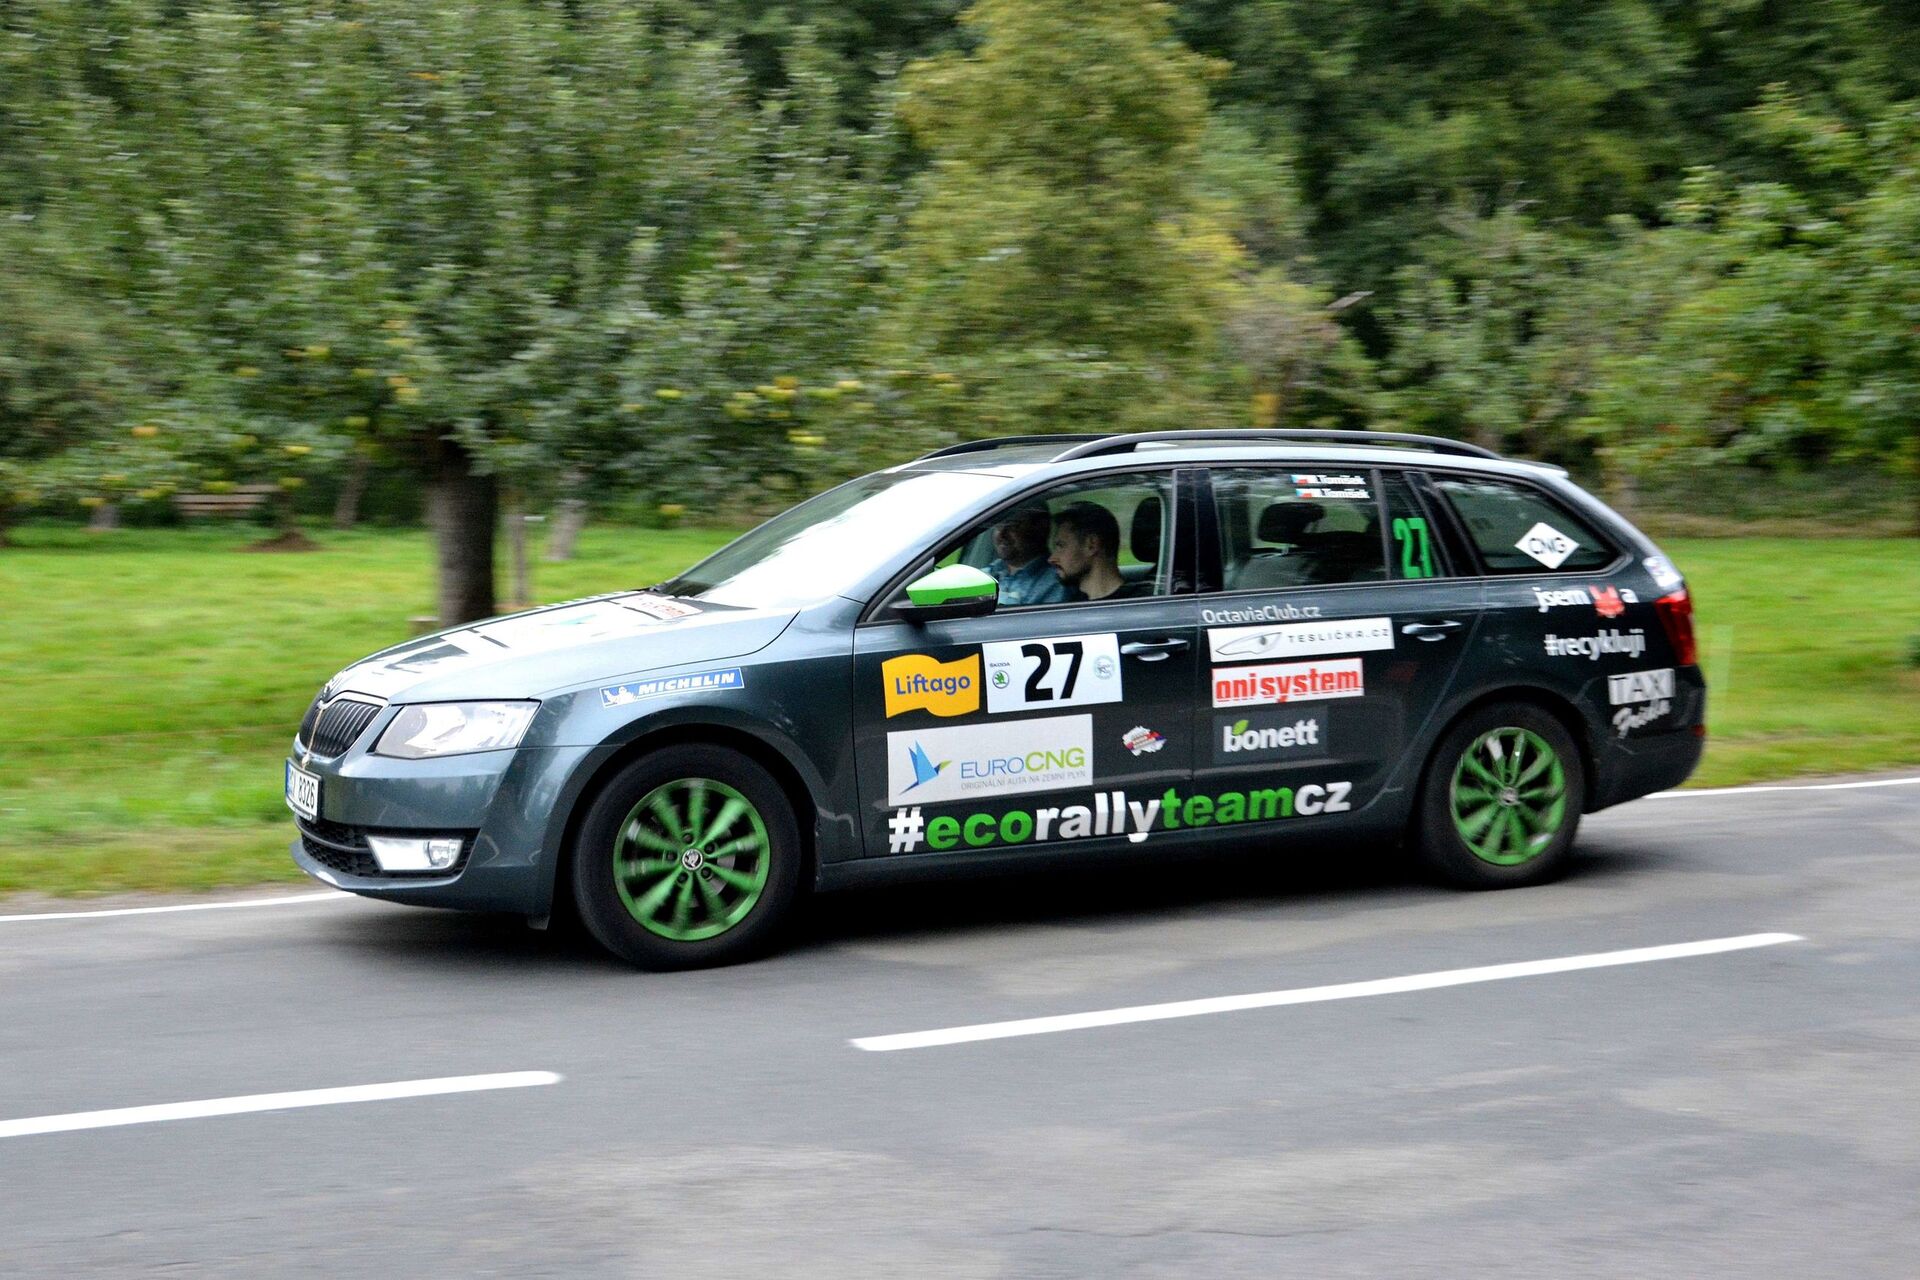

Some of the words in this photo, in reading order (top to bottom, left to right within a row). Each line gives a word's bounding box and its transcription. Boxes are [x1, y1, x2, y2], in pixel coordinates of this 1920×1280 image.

[1393, 518, 1434, 579] 27
[1528, 537, 1567, 554] CNG
[1202, 603, 1322, 624] OctaviaClub.cz
[1532, 587, 1591, 612] jsem
[1543, 629, 1646, 660] #recykluji
[638, 672, 735, 696] MICHELIN
[895, 674, 971, 695] Liftago
[1020, 641, 1084, 702] 27
[1223, 718, 1319, 752] bonett
[961, 747, 1085, 779] EUROCNG
[888, 781, 1353, 853] #ecorallyteamcz
